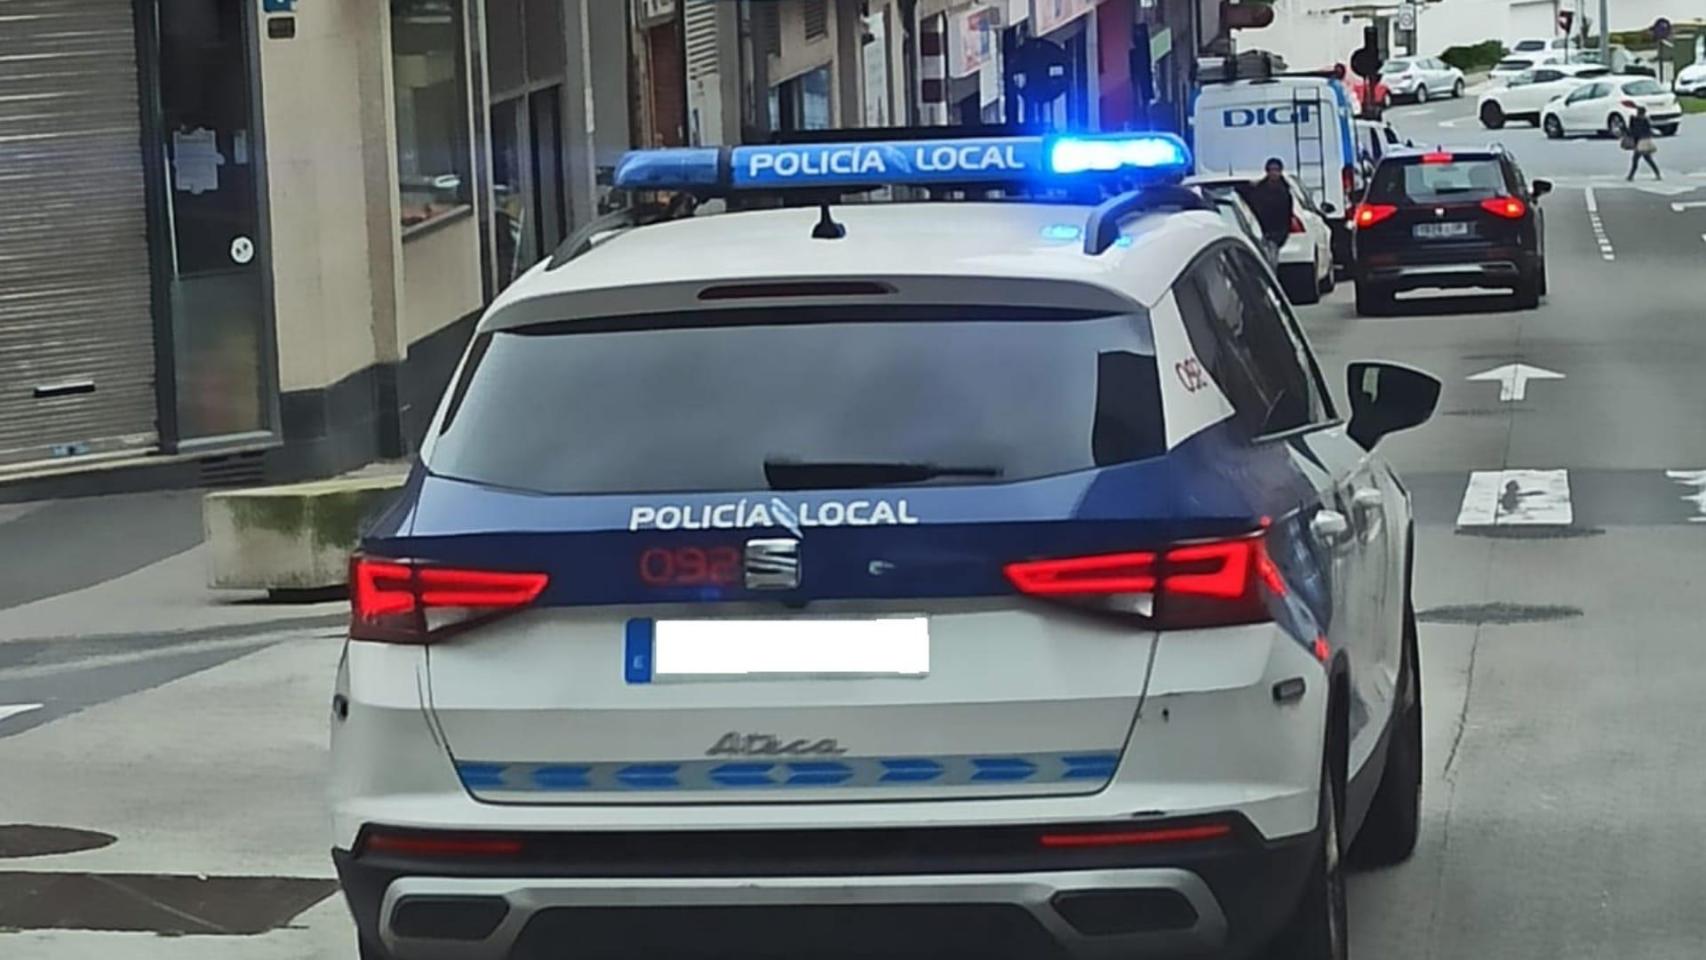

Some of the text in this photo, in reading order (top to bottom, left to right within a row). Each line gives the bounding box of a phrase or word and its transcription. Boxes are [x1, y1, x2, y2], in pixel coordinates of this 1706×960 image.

[1223, 104, 1310, 128] DIGI
[749, 144, 1024, 177] POLICÍA LOCAL
[629, 498, 919, 531] POLICÍA LOCAL
[639, 546, 739, 586] 092
[704, 731, 848, 756] Ateca
